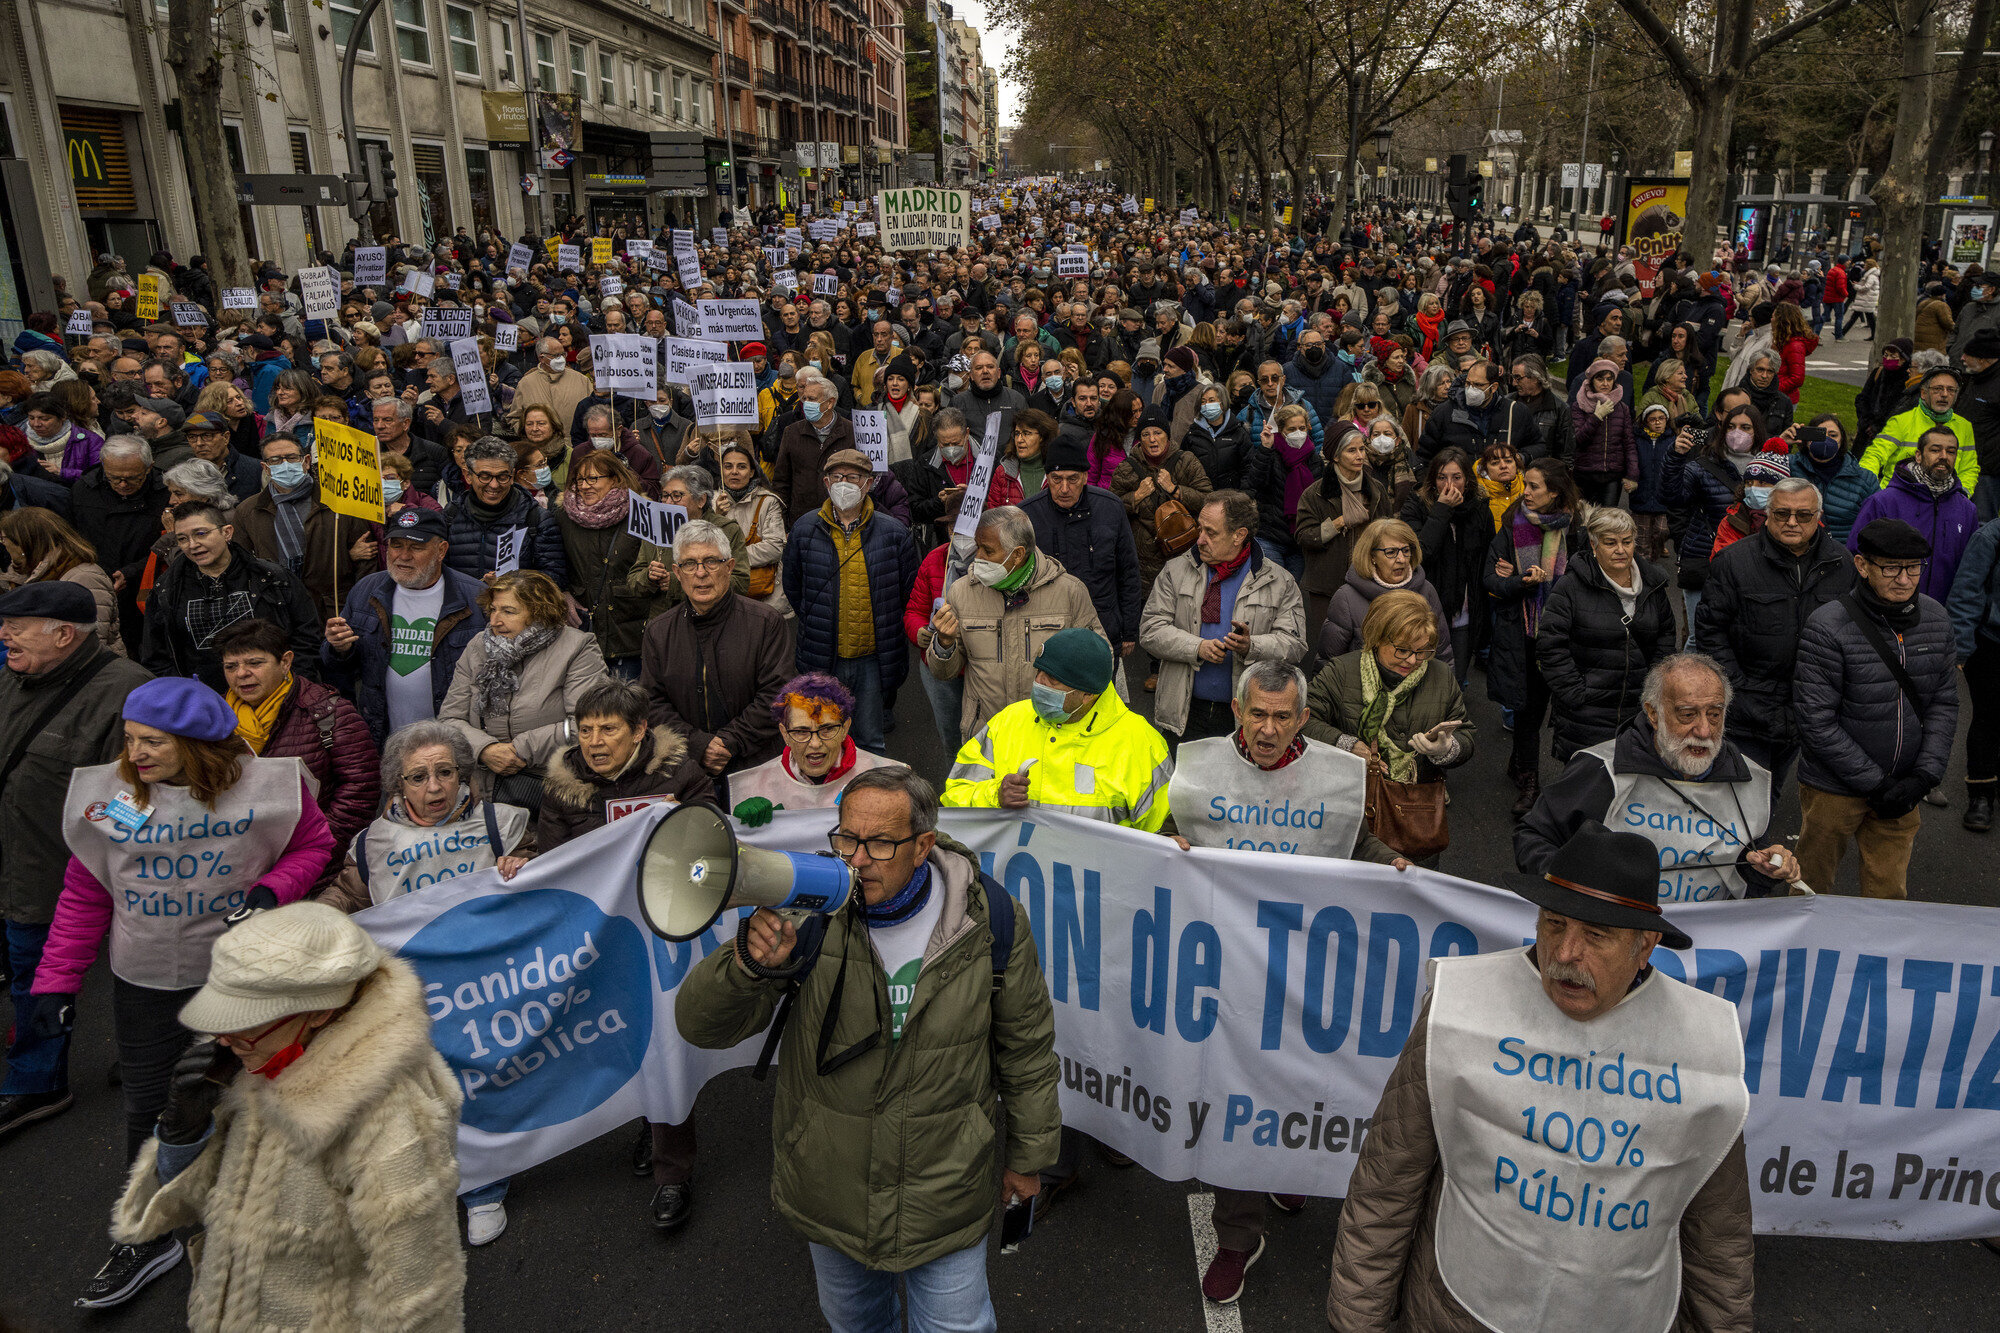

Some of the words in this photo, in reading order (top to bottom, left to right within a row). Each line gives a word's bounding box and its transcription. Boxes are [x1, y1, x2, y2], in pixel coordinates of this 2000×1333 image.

[497, 114, 501, 122] y
[503, 112, 526, 120] frutos
[502, 105, 525, 113] flores
[719, 168, 728, 179] P
[884, 189, 962, 214] MADRID
[1633, 189, 1665, 208] ¡NUEVO!
[886, 215, 899, 230] EN
[902, 213, 928, 229] LUCHA
[931, 214, 947, 229] POR
[951, 215, 963, 230] LA
[890, 231, 926, 247] SANIDAD
[356, 252, 385, 262] AYUSO:
[777, 250, 785, 266] NO
[300, 271, 327, 280] SOBRAN
[356, 264, 384, 274] ¡Privatizar
[1060, 266, 1087, 274] ABUSO.
[364, 274, 384, 283] robar!
[827, 279, 837, 294] NO
[222, 289, 231, 297] SE
[305, 289, 332, 301] FALTAN
[173, 304, 181, 312] SE
[183, 303, 198, 312] VEN
[225, 298, 233, 307] TU
[307, 301, 336, 313] MEDICOS
[177, 313, 186, 323] TU
[426, 309, 438, 320] SE
[440, 310, 470, 320] VENDE
[704, 305, 717, 317] Sin
[717, 304, 757, 319] Urgencias,
[426, 324, 437, 337] TU
[438, 323, 467, 337] SALUD.
[708, 323, 724, 333] más
[725, 324, 759, 333] muertos.
[615, 350, 639, 360] Ayuso
[671, 344, 695, 359] Clasista
[696, 349, 700, 359] e
[701, 348, 727, 363] incapaz.
[606, 367, 643, 378] abusos.
[690, 372, 753, 396] ¡¡¡MISERABLES!!!
[719, 397, 755, 415] Sanidad!
[336, 440, 353, 462] nos
[355, 441, 377, 471] cierra
[336, 472, 349, 499] de
[352, 476, 383, 508] Salud!
[630, 498, 657, 545] ASÍ,
[1207, 795, 1326, 830] Sanidad
[109, 809, 254, 844] Sanidad
[135, 851, 232, 881] 100%
[125, 889, 248, 917] Pública
[1130, 885, 1223, 1043] de
[423, 930, 600, 1022] Sanidad
[462, 985, 591, 1059] 100%
[460, 1009, 628, 1101] Pública
[1492, 1035, 1683, 1105] Sanidad
[1520, 1104, 1645, 1168] 100%
[1184, 1100, 1211, 1150] y
[1759, 1145, 1817, 1195] de
[1831, 1150, 1875, 1199] la
[1494, 1155, 1650, 1233] Pública
